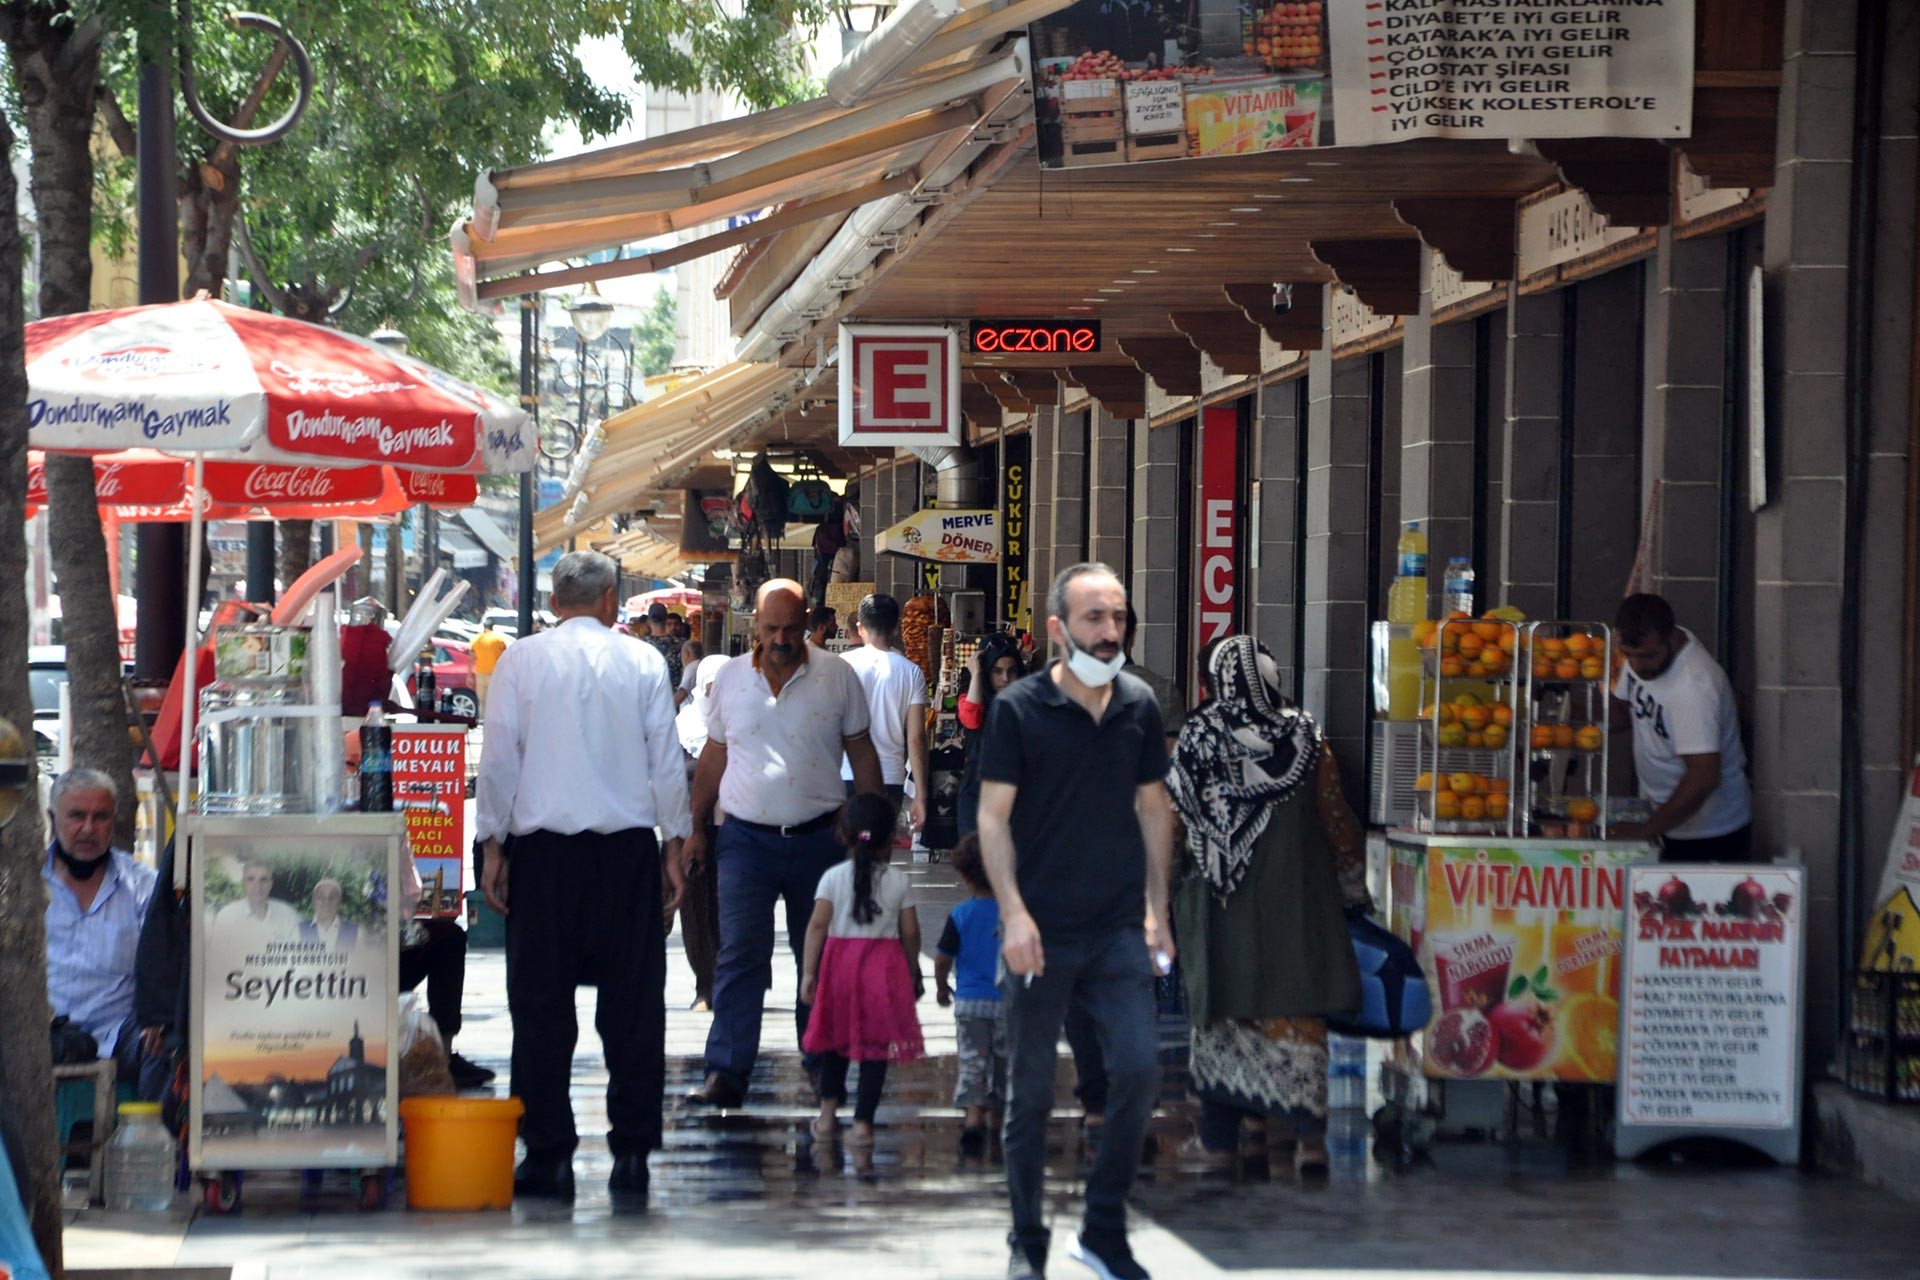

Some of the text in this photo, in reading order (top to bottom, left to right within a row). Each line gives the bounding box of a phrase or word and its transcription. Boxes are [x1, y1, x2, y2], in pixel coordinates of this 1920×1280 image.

[1389, 61, 1570, 80] PROSTAT ŞİFASI
[1389, 97, 1475, 114] YÜKSEK
[976, 328, 1095, 352] eczane
[873, 350, 931, 419] E
[143, 399, 232, 440] Gaymak
[287, 408, 382, 444] Dondurmam
[378, 419, 455, 456] Gaymak
[942, 513, 994, 530] MERVE
[1007, 465, 1022, 556] ÇUKUR
[941, 532, 994, 555] DÖNER
[392, 759, 456, 773] MEYAN
[1444, 851, 1624, 910] VİTAMİN
[1453, 932, 1496, 960] SIKMA
[1575, 929, 1610, 951] SIKMA
[224, 967, 369, 1009] Seyfettin
